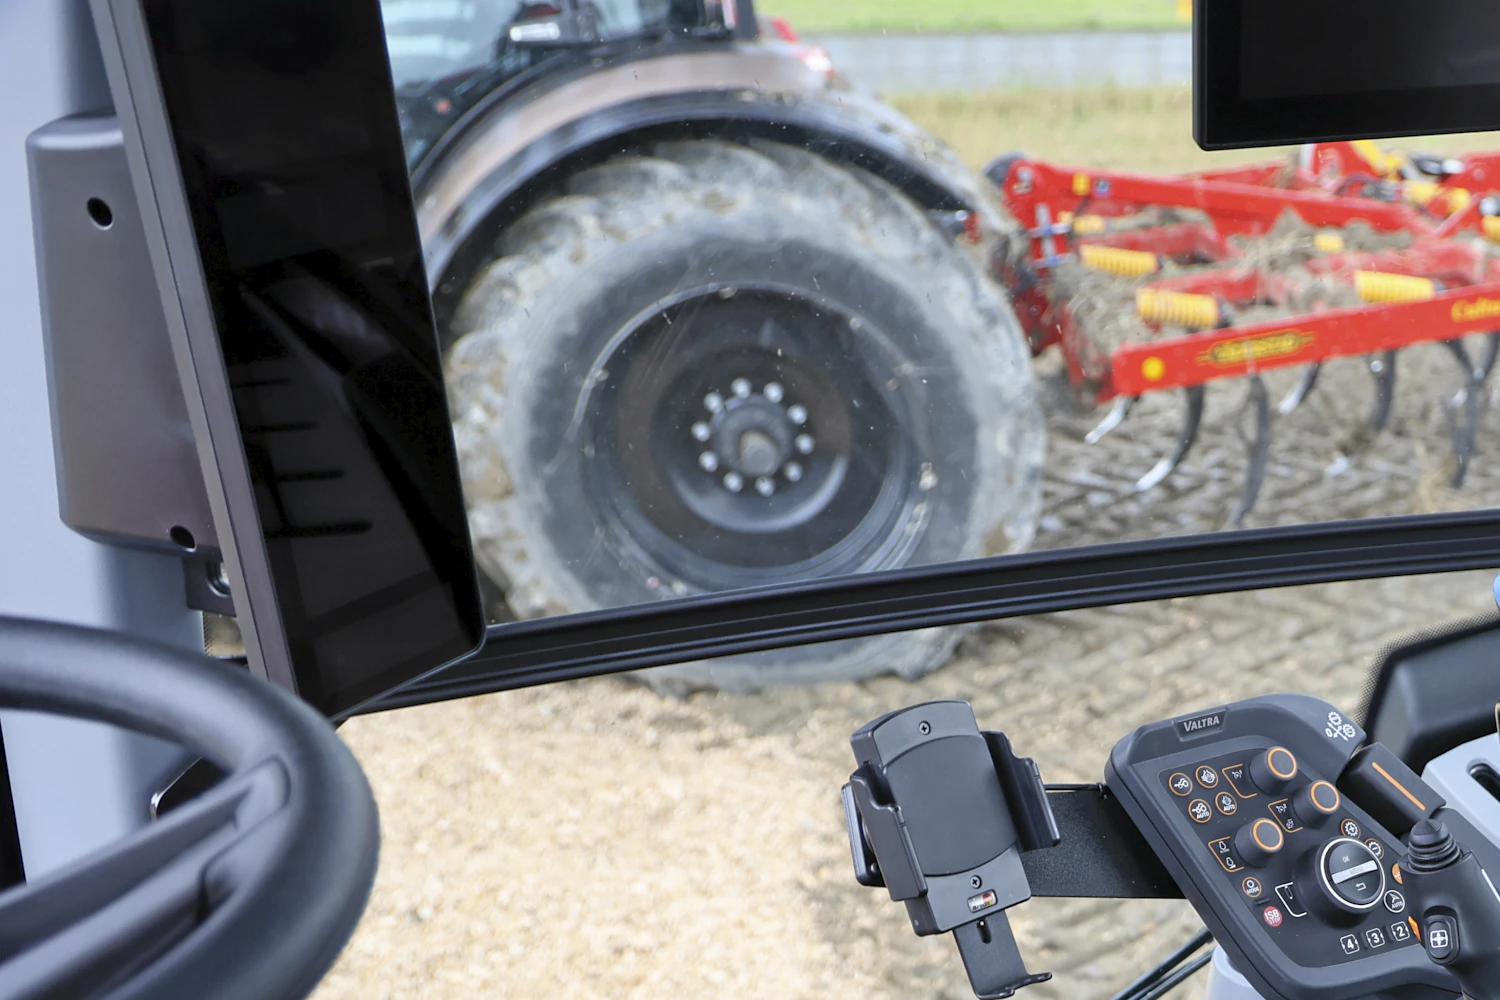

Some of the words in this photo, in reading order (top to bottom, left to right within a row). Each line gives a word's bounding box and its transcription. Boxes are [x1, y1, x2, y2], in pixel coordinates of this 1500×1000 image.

[1183, 716, 1220, 732] VALTRA
[1223, 803, 1236, 812] AUTO
[1196, 811, 1210, 819] AUTO
[1342, 855, 1350, 863] OK
[1391, 900, 1403, 909] AUTO
[1264, 909, 1280, 921] ISB
[1396, 926, 1405, 937] 2
[1371, 932, 1380, 943] 3
[1347, 938, 1355, 950] 4
